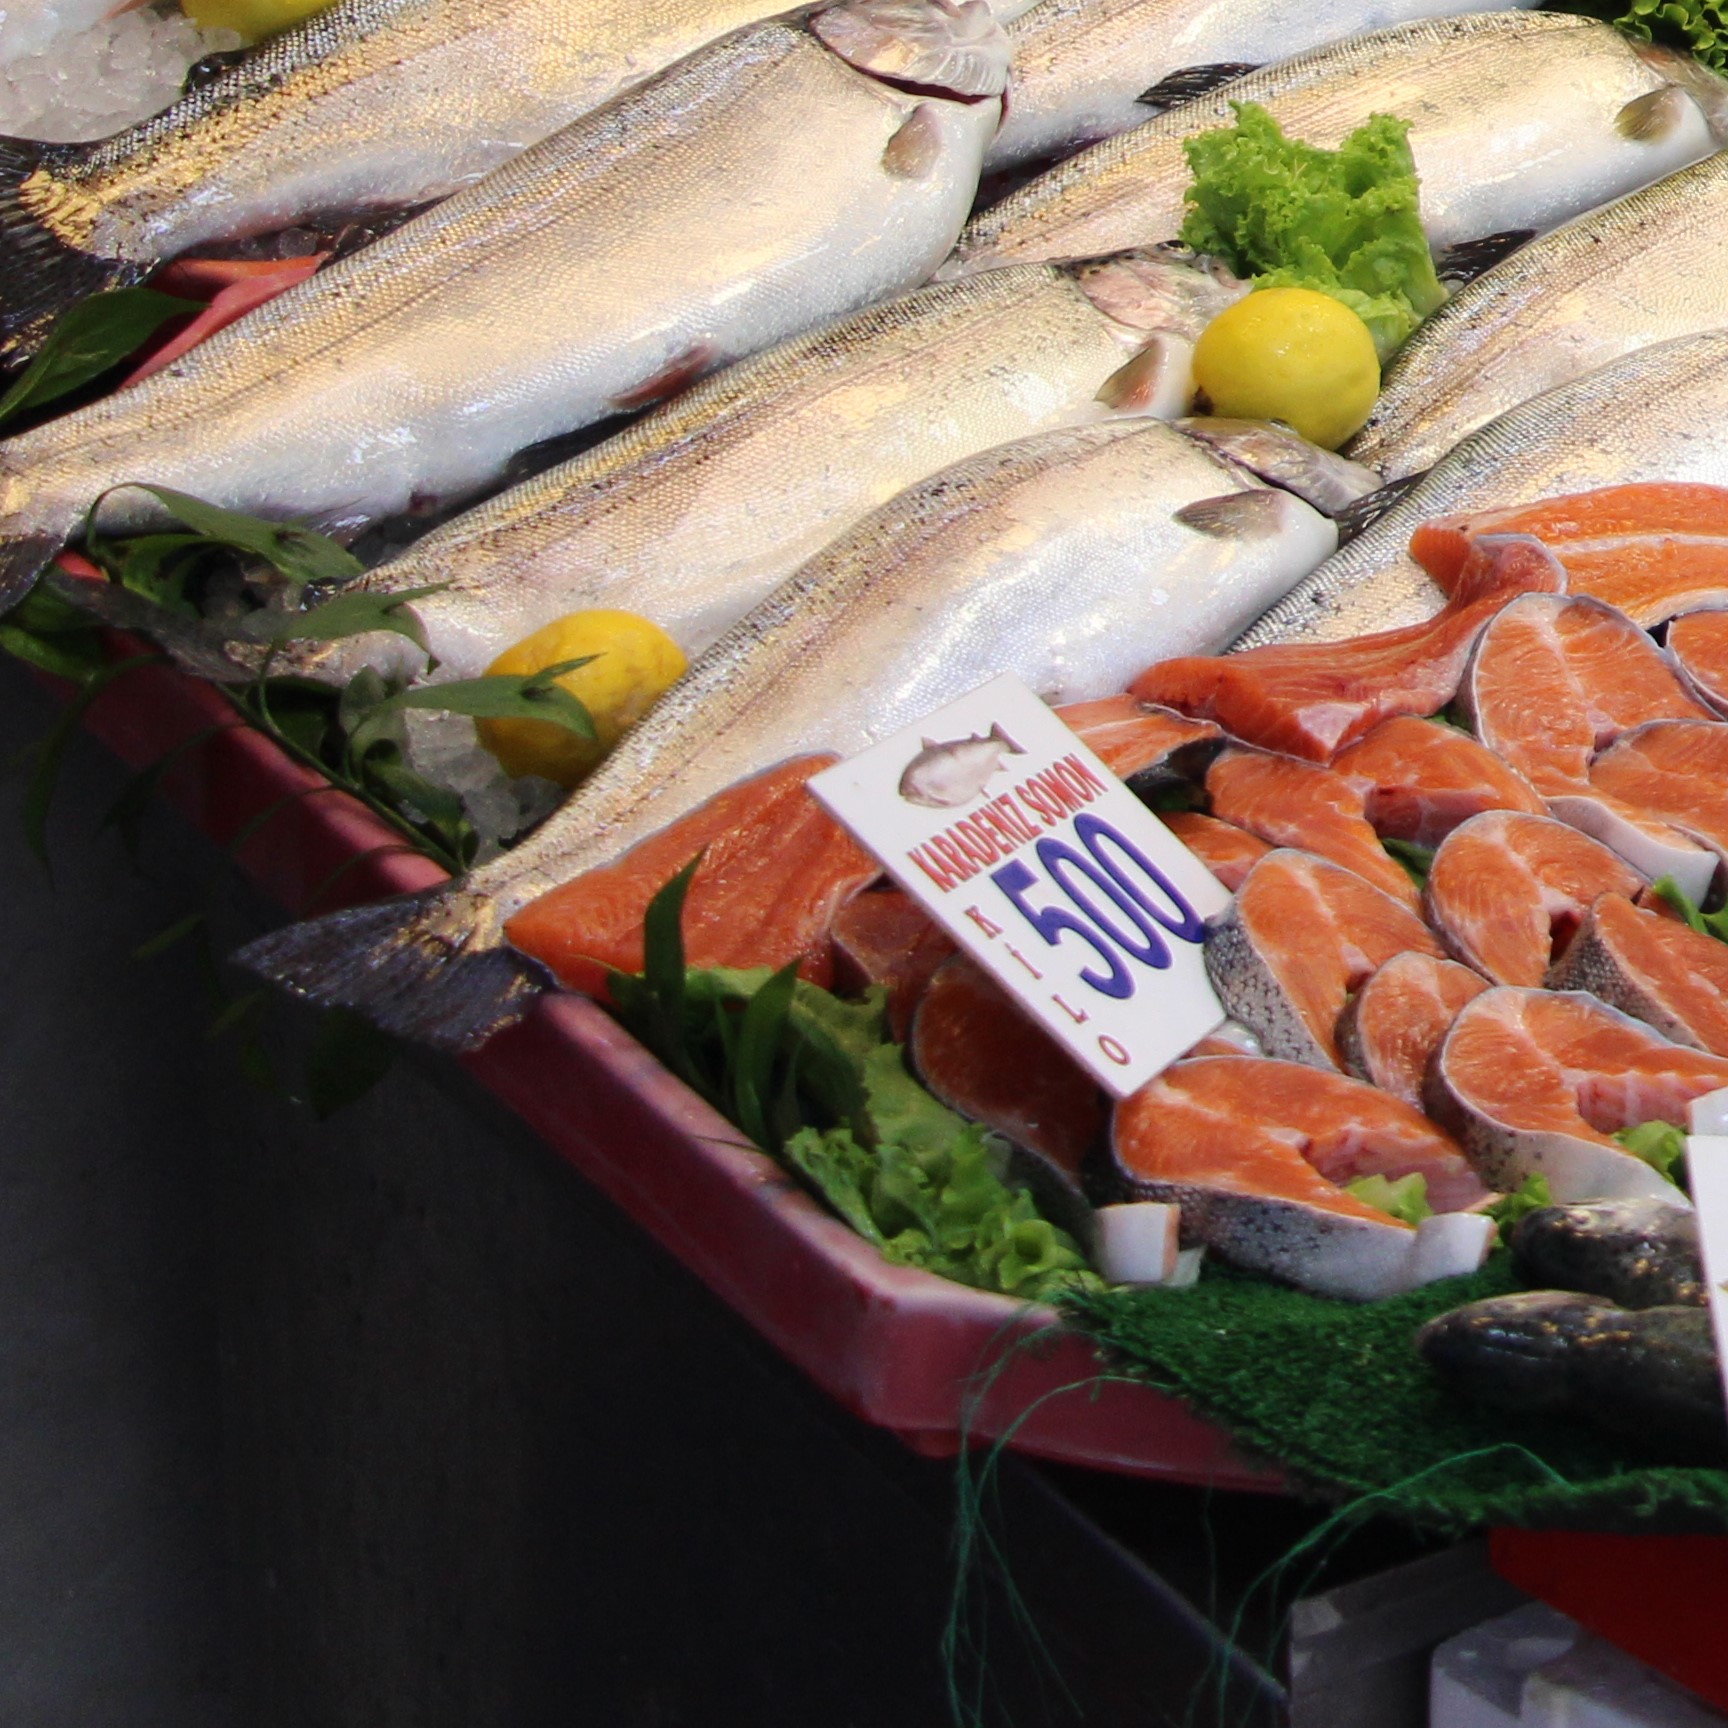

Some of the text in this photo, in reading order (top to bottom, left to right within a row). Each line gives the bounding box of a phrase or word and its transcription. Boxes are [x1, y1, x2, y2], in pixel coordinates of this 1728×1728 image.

[908, 753, 1108, 893] KARADENİZ SOMON
[990, 812, 1207, 1000] 500
